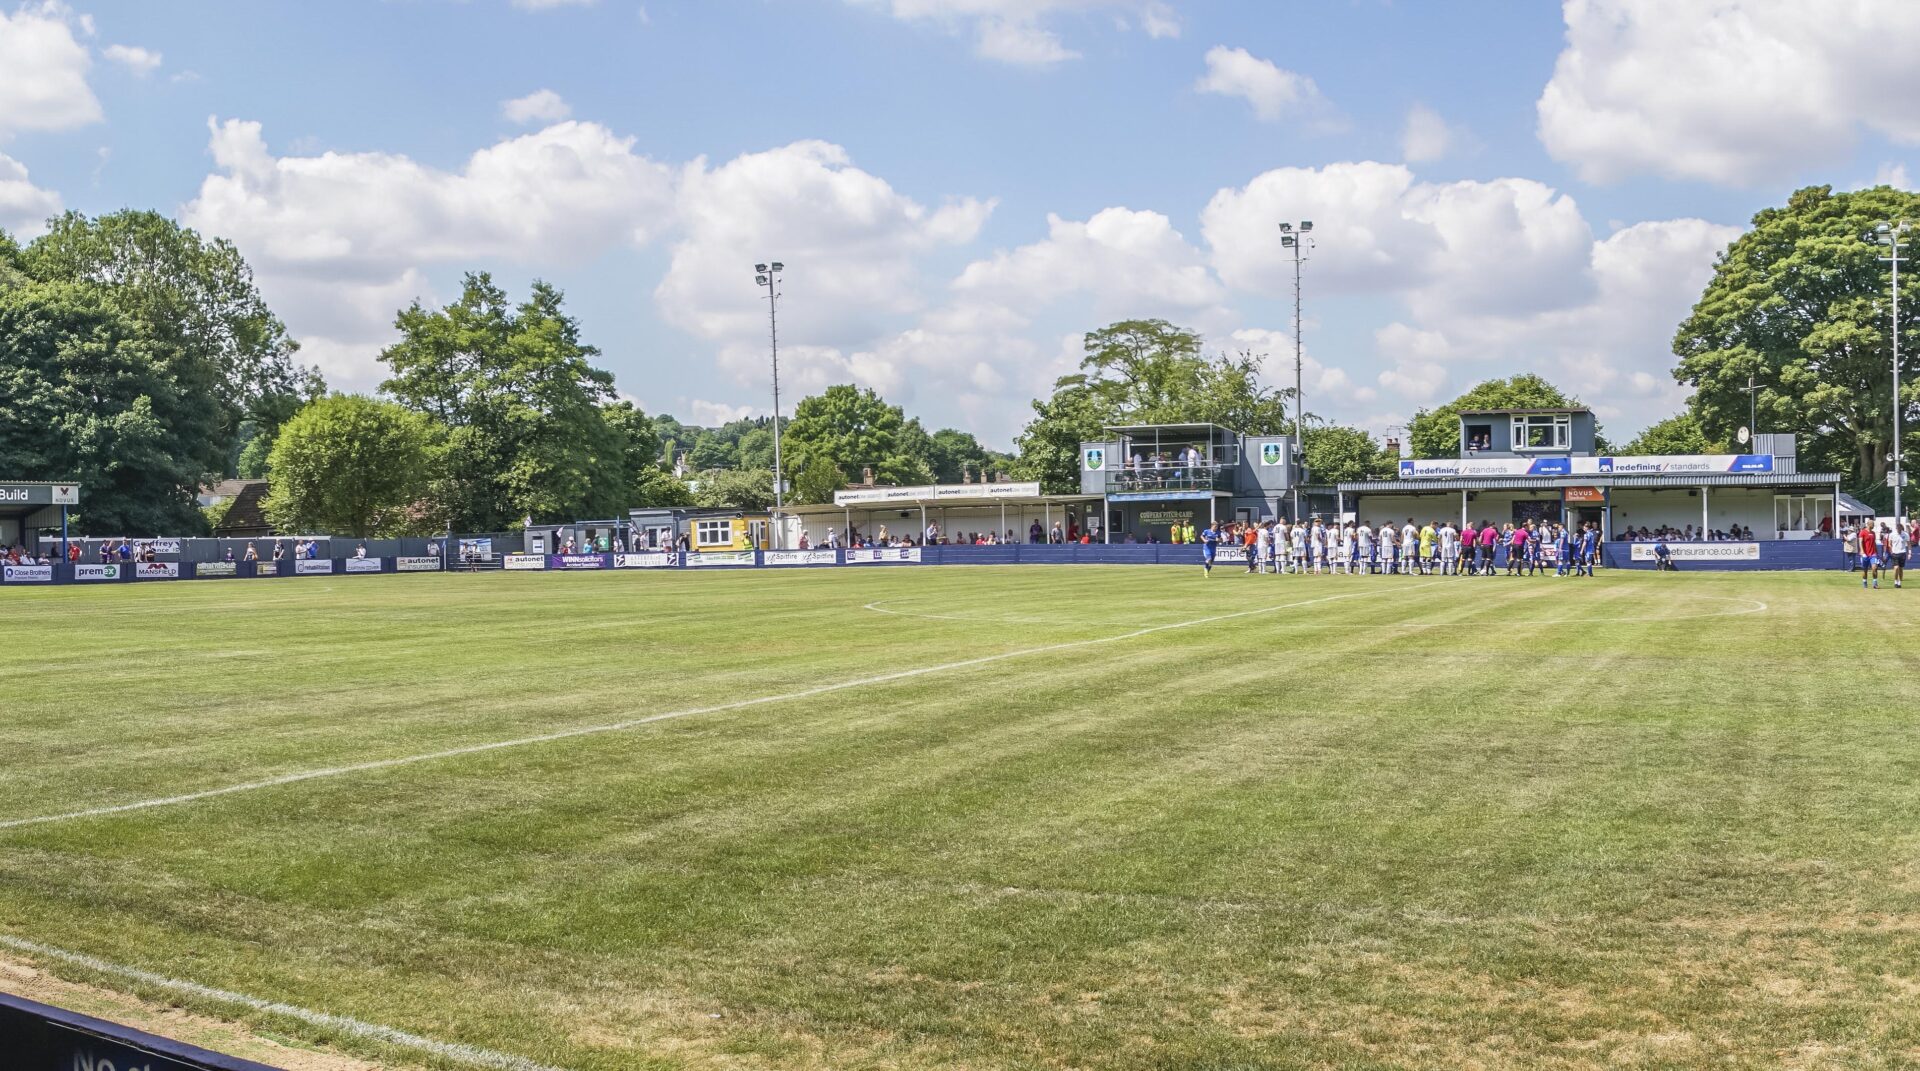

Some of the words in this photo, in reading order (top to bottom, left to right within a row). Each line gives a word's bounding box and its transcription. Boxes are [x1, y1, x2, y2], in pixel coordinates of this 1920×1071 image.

[1416, 467, 1460, 475] redefining
[1469, 466, 1508, 474] standards
[1616, 463, 1661, 472] redefining
[1670, 463, 1710, 471] standards
[1646, 547, 1744, 556] auetinsurance.co.uk
[811, 552, 834, 560] Spitfire
[407, 557, 439, 565] autonet
[79, 568, 116, 576] premex
